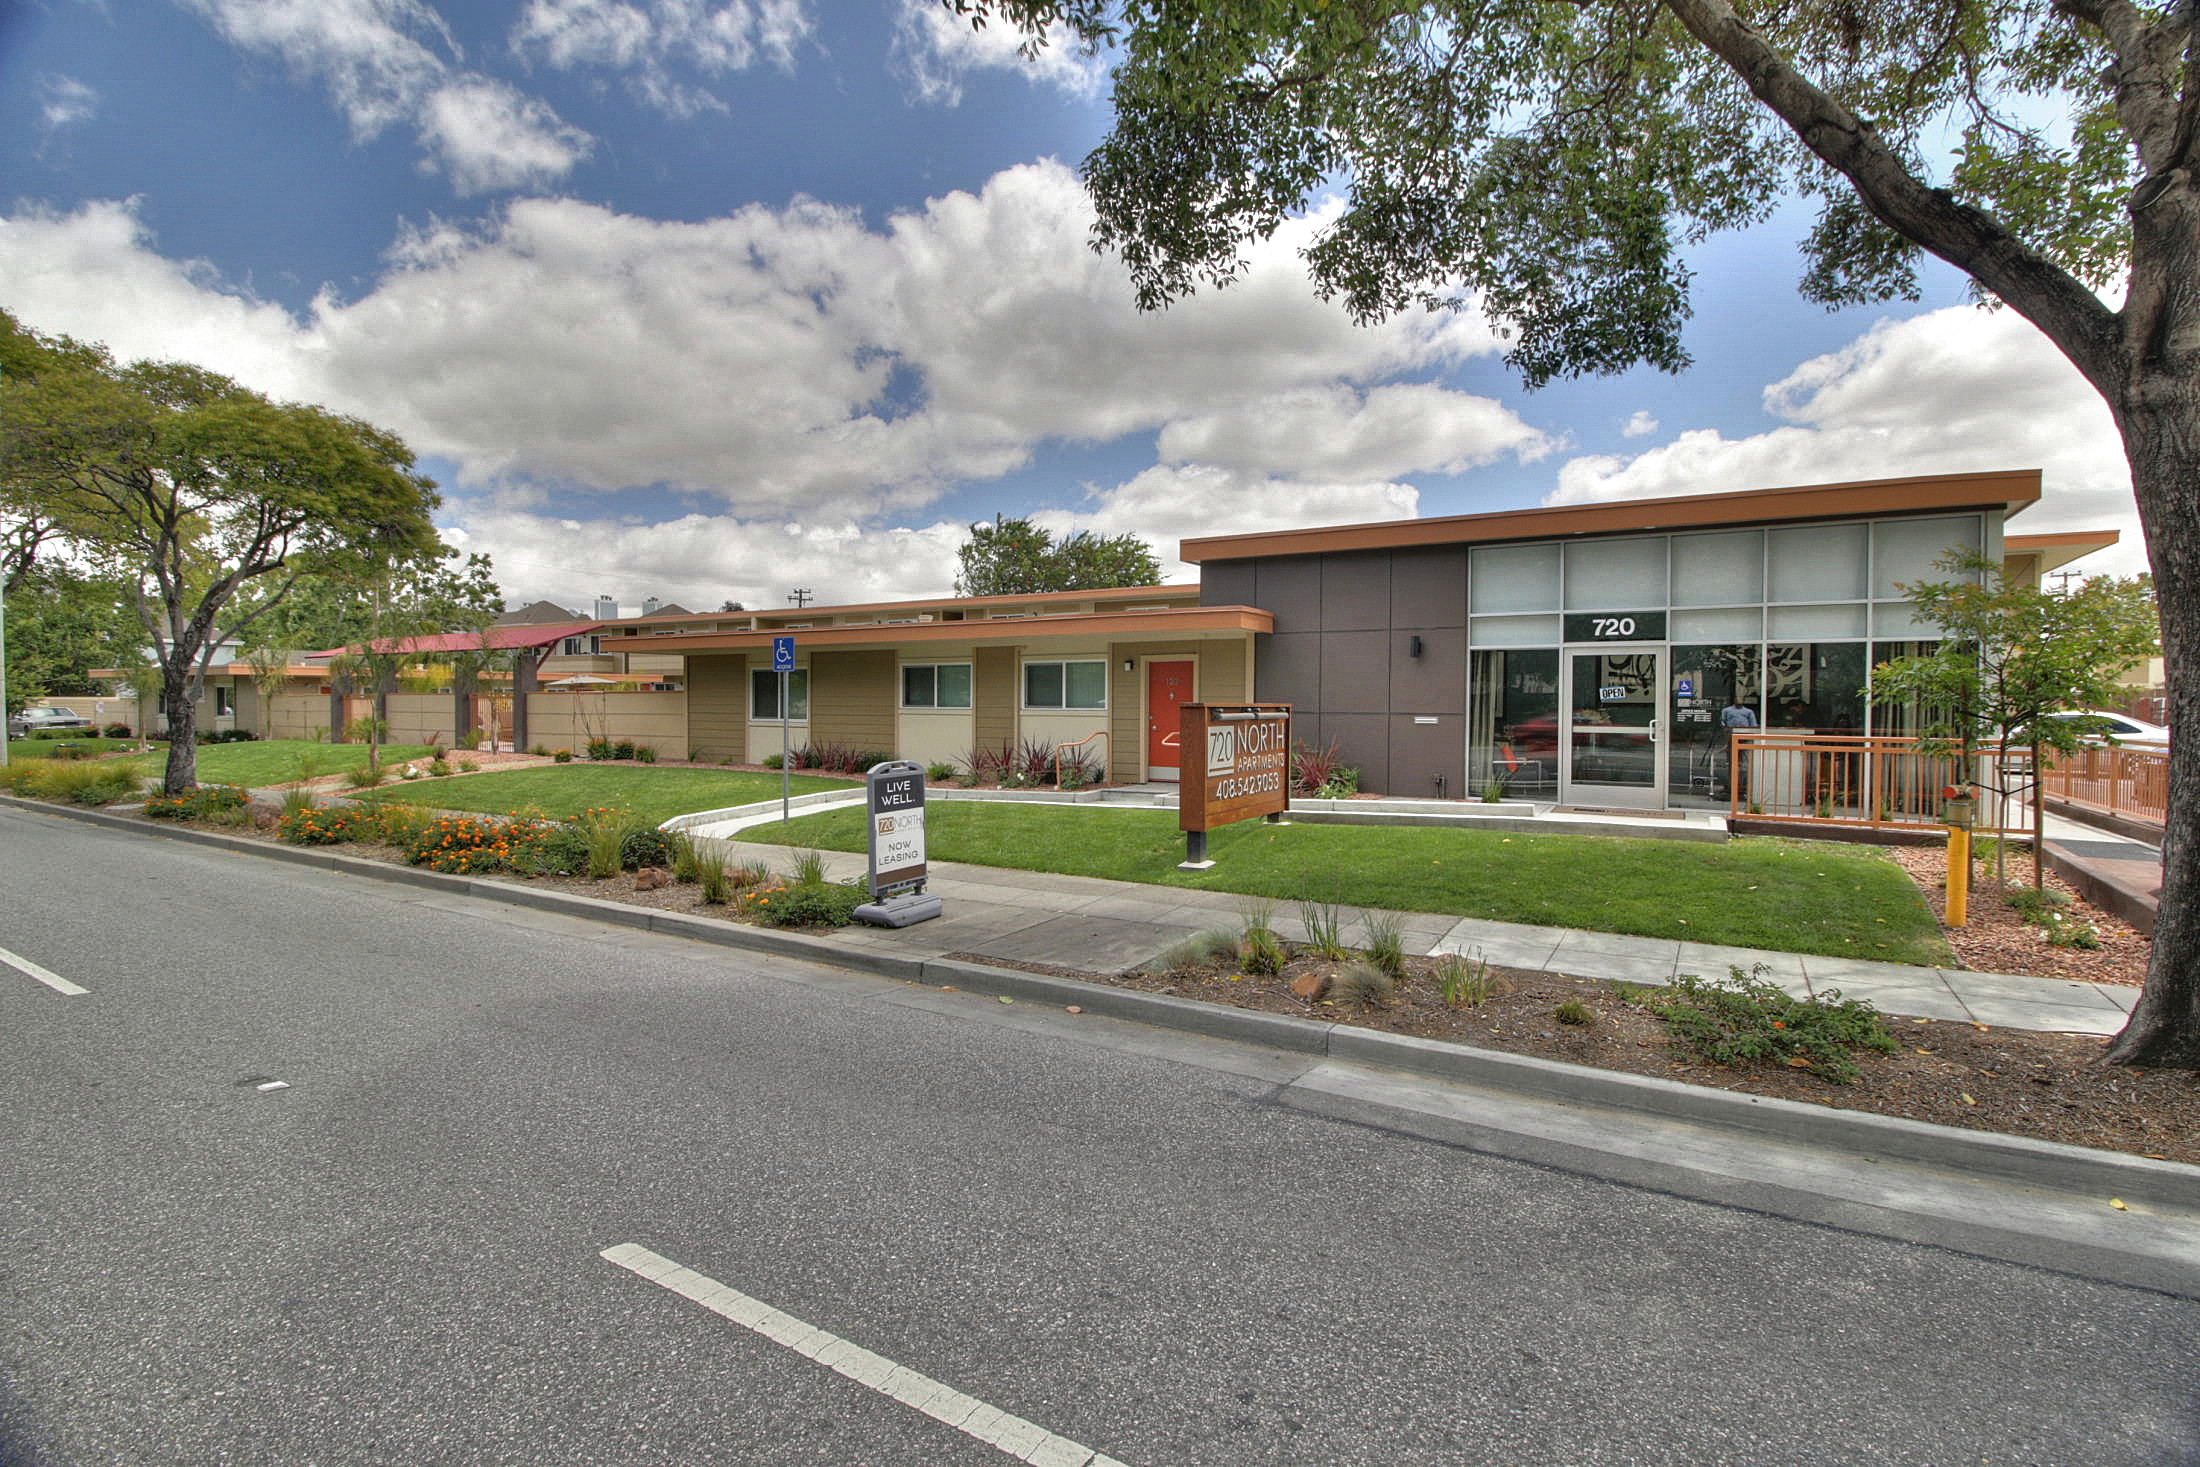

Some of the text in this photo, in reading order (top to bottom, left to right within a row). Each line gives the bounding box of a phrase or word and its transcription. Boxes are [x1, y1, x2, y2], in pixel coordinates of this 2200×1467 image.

[1592, 617, 1635, 636] 720
[1602, 687, 1623, 698] OPEN
[1210, 722, 1285, 763] 720 NORTH
[1237, 752, 1285, 773] APARTMENTS
[887, 780, 911, 793] LIVE
[1216, 772, 1279, 800] 408.542.9053
[881, 793, 916, 806] WELL.
[879, 818, 896, 833] 720
[888, 840, 911, 852] NOW
[879, 850, 919, 865] LEASING
